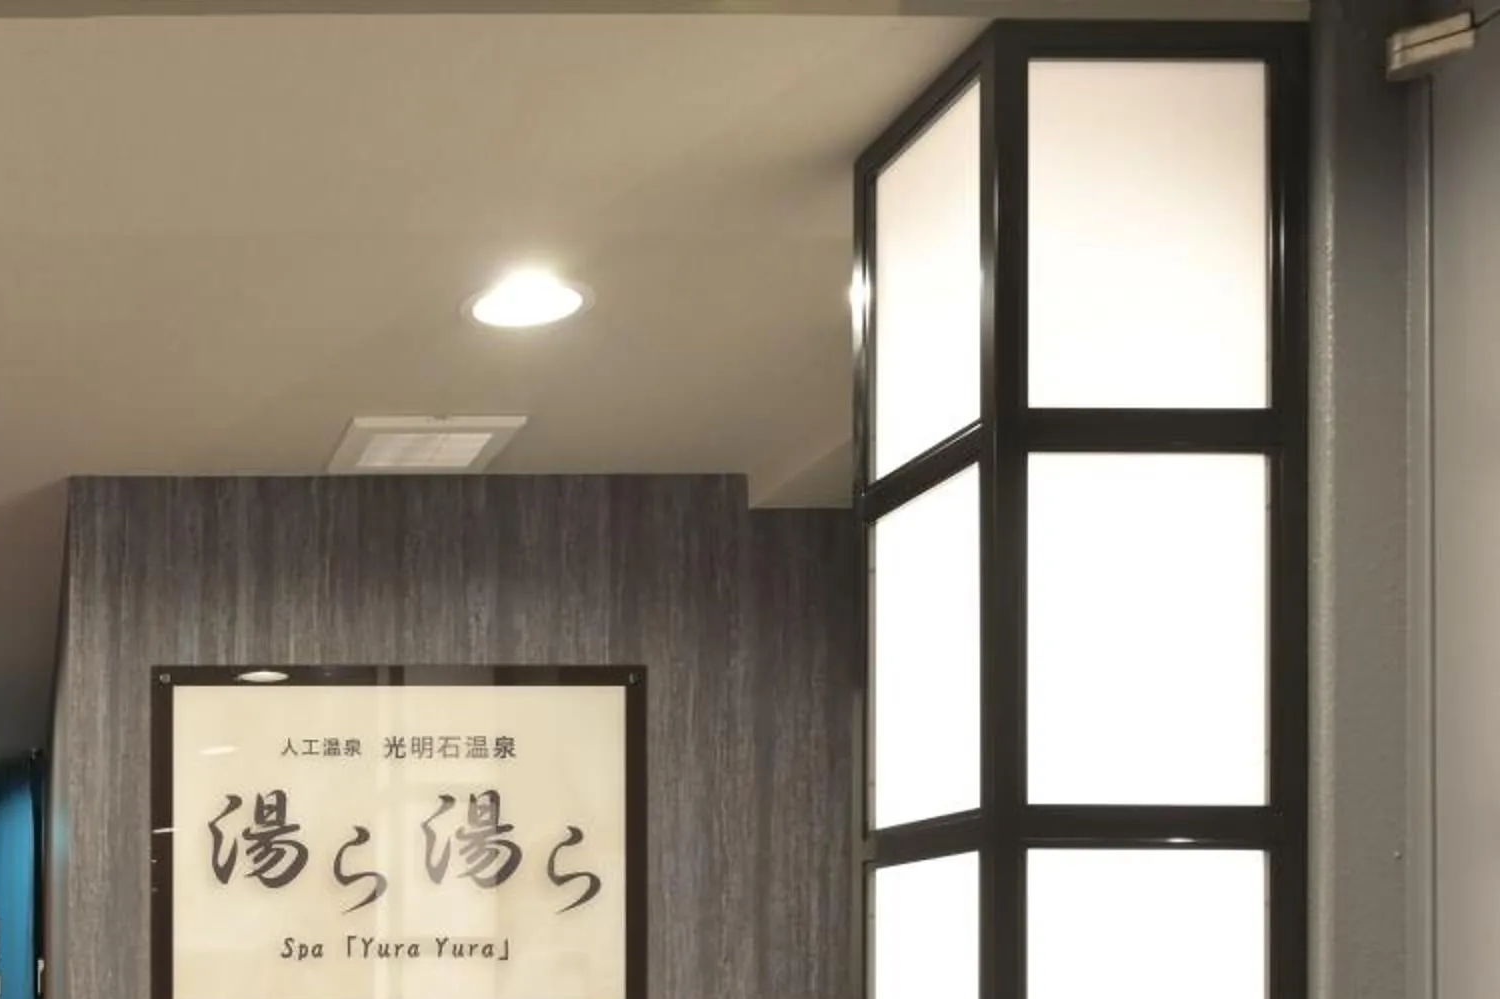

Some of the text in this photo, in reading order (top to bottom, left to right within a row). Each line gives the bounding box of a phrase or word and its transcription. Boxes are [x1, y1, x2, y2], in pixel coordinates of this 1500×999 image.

[280, 735, 517, 759] 人工温泉 光明石温泉
[207, 789, 602, 915] 湯ら湯ら
[280, 937, 324, 961] Spa
